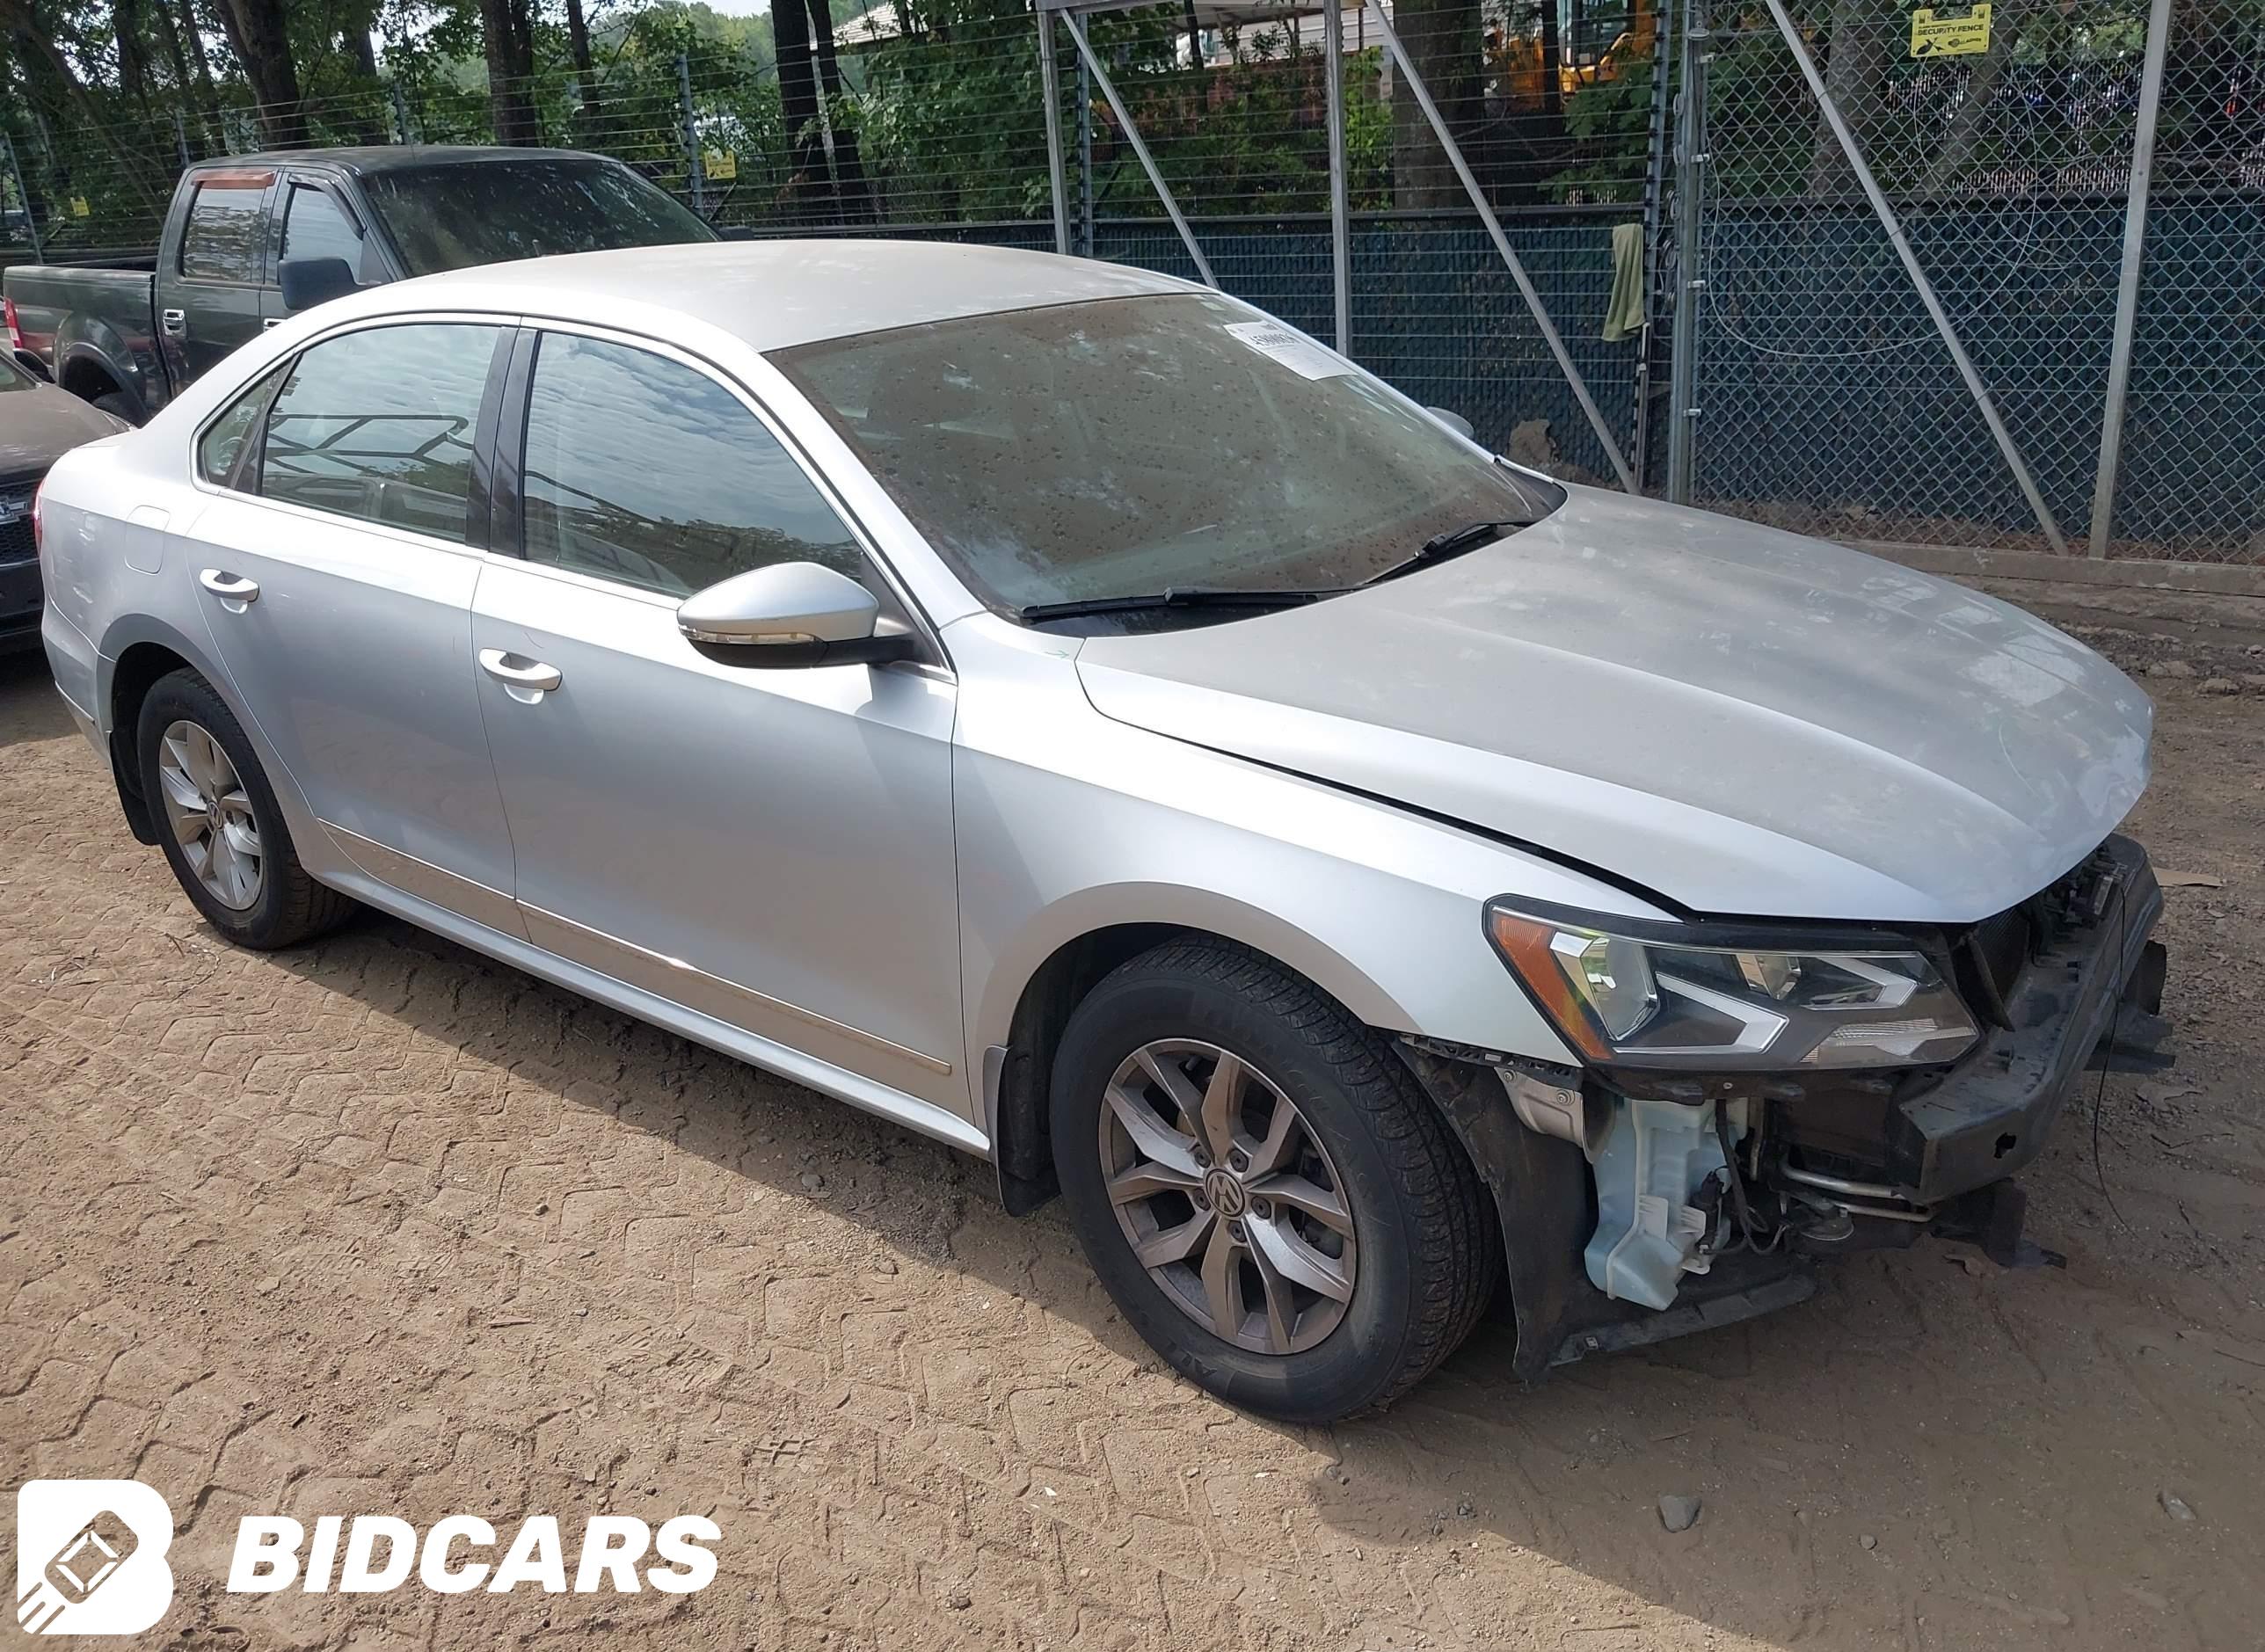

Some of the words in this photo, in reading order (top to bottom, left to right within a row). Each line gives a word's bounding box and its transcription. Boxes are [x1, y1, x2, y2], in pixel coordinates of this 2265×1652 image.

[1918, 26, 1957, 36] SECURITY
[1957, 24, 1985, 33] FENCE
[1206, 1169, 1245, 1217] VW
